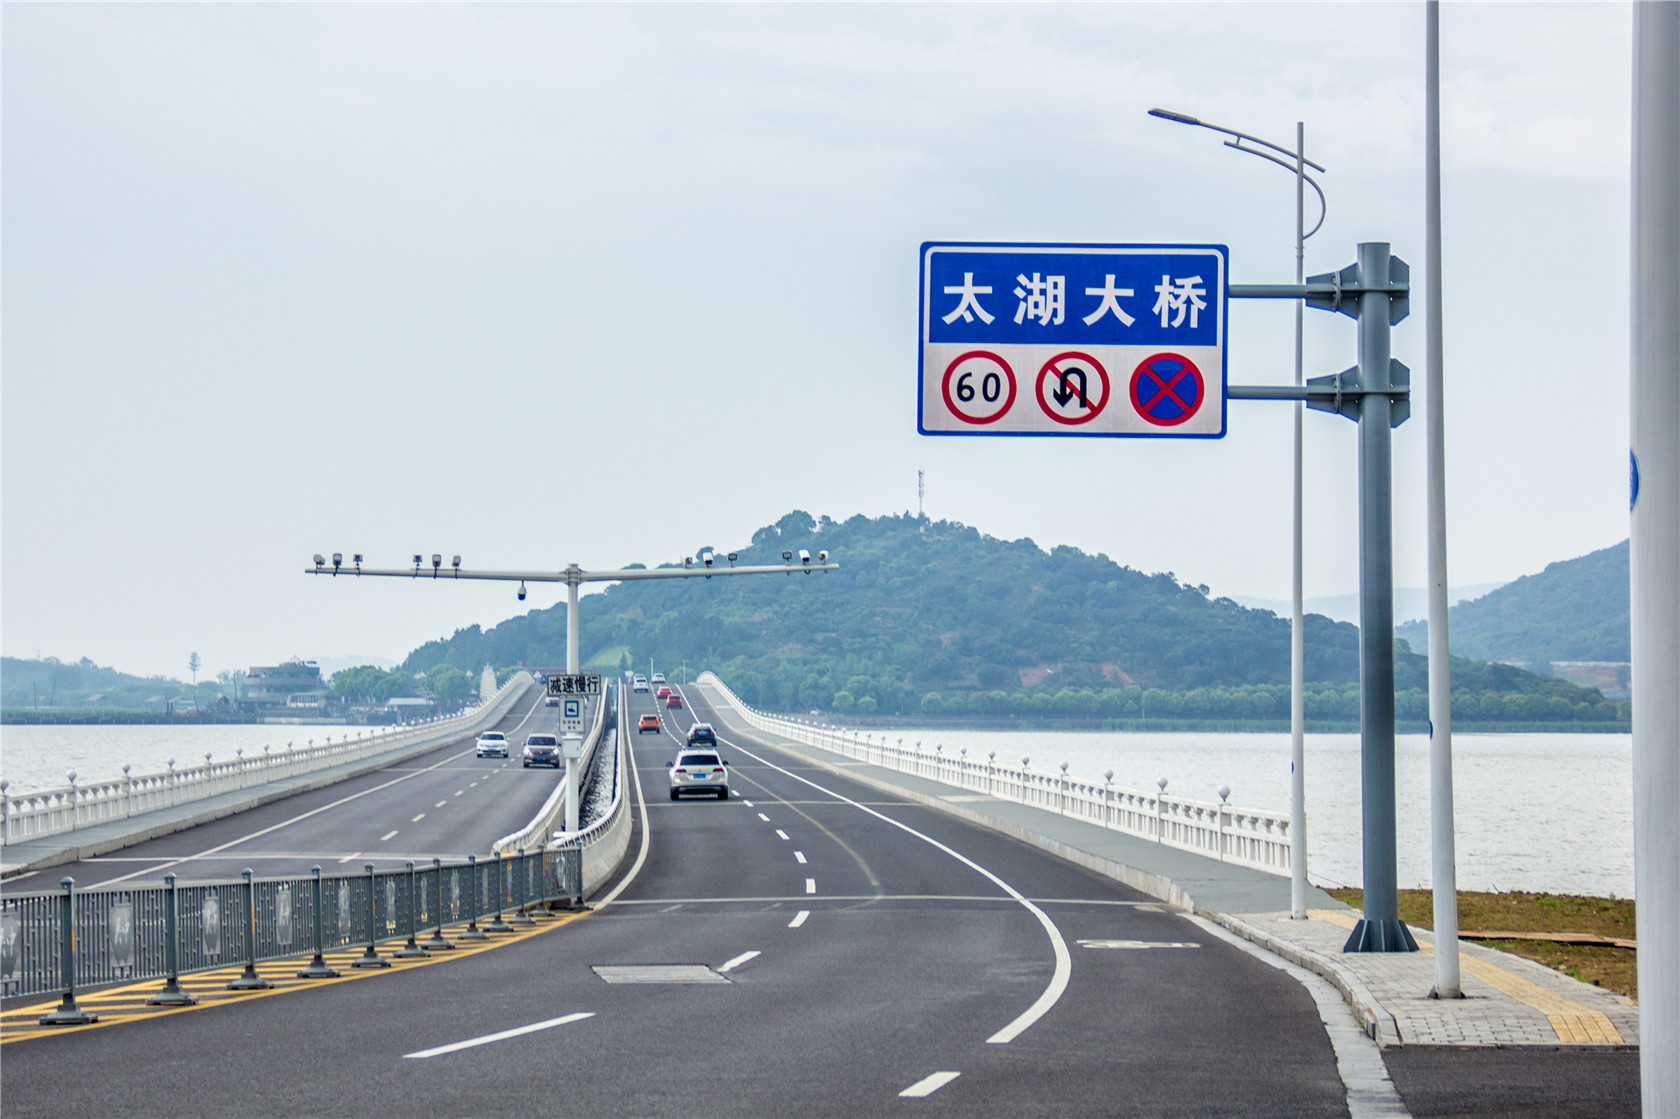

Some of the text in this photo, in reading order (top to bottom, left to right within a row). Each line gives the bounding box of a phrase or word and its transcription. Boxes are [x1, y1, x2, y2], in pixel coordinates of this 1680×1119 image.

[942, 272, 1207, 328] 太湖大桥
[957, 372, 1001, 402] 60
[550, 676, 599, 693] 减速慢行
